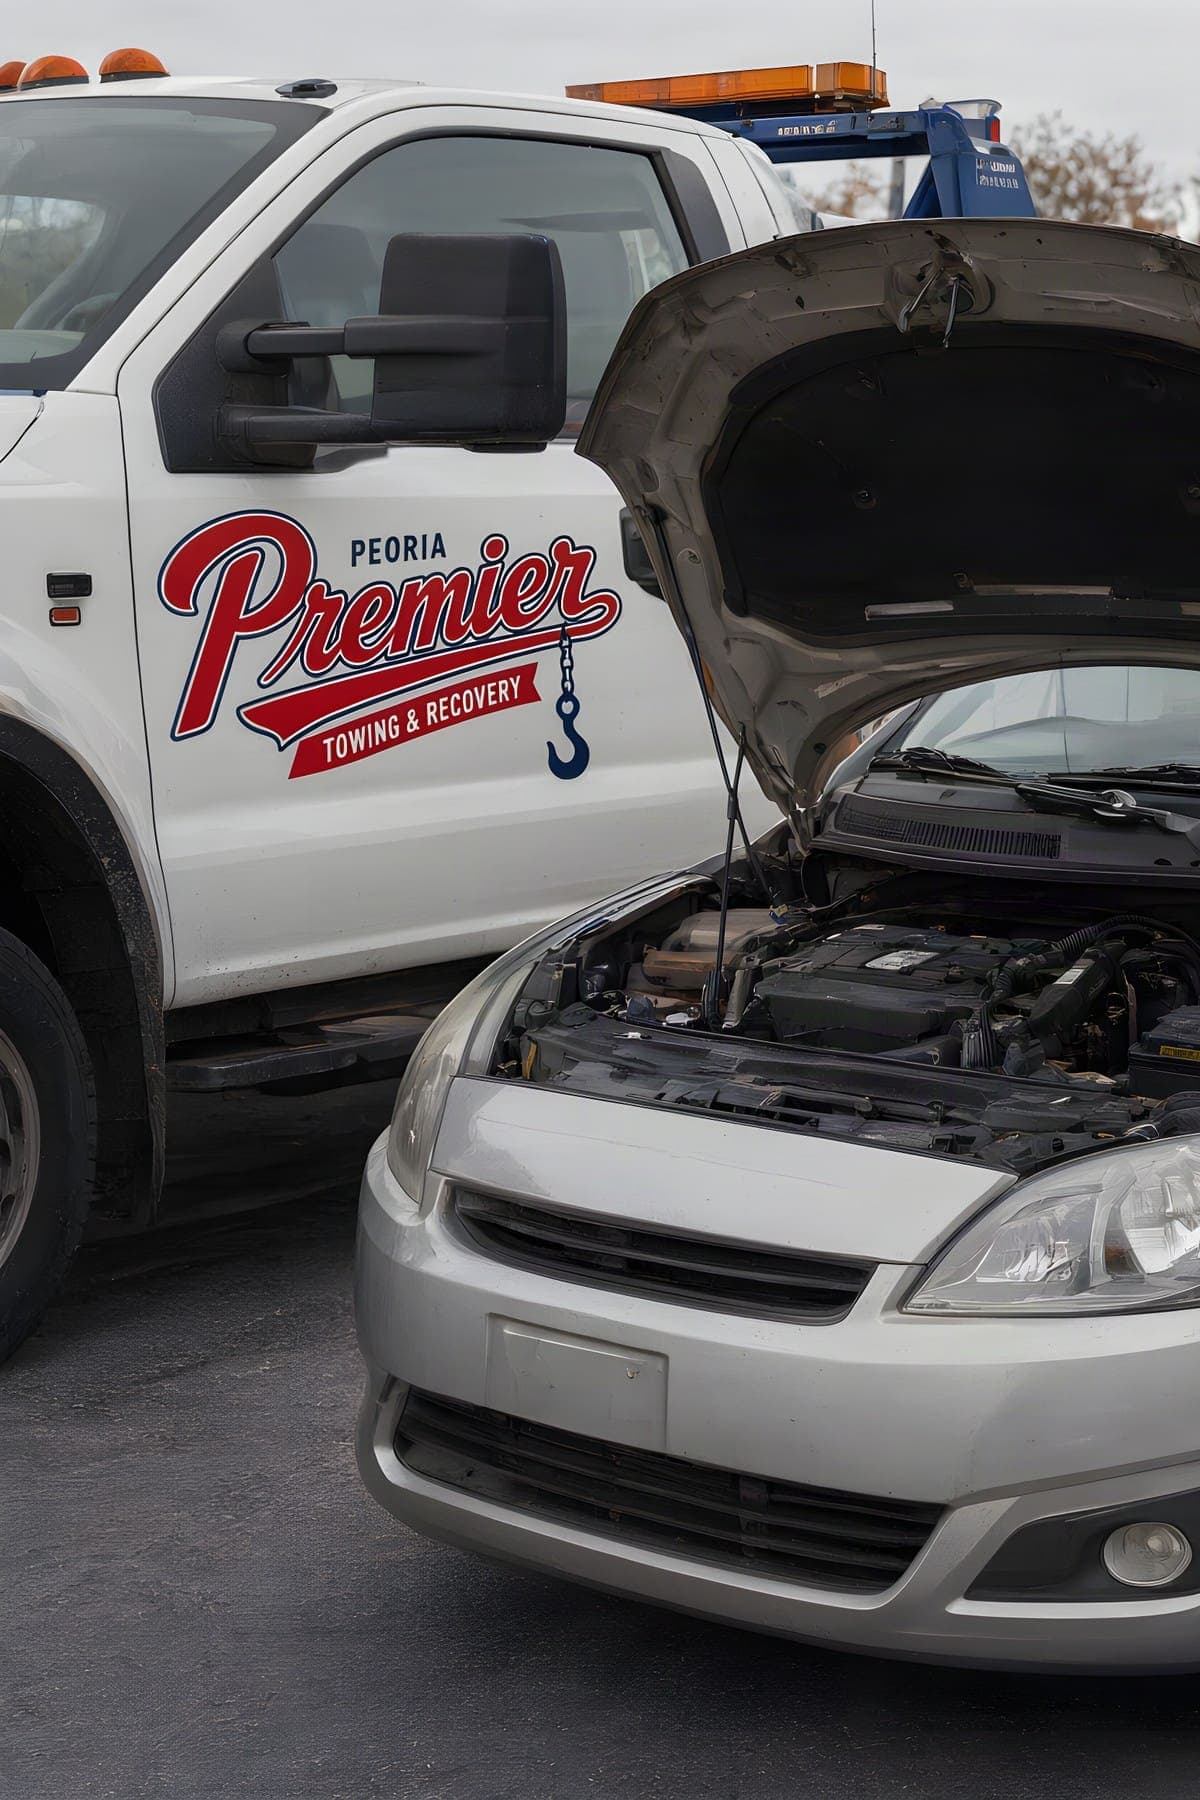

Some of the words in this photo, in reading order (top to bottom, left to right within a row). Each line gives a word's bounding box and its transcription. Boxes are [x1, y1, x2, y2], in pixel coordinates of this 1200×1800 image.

[351, 533, 447, 567] PEORIA
[157, 508, 622, 742] Premier
[323, 714, 400, 763] TOWING
[406, 708, 420, 732] &
[426, 675, 521, 726] RECOVERY
